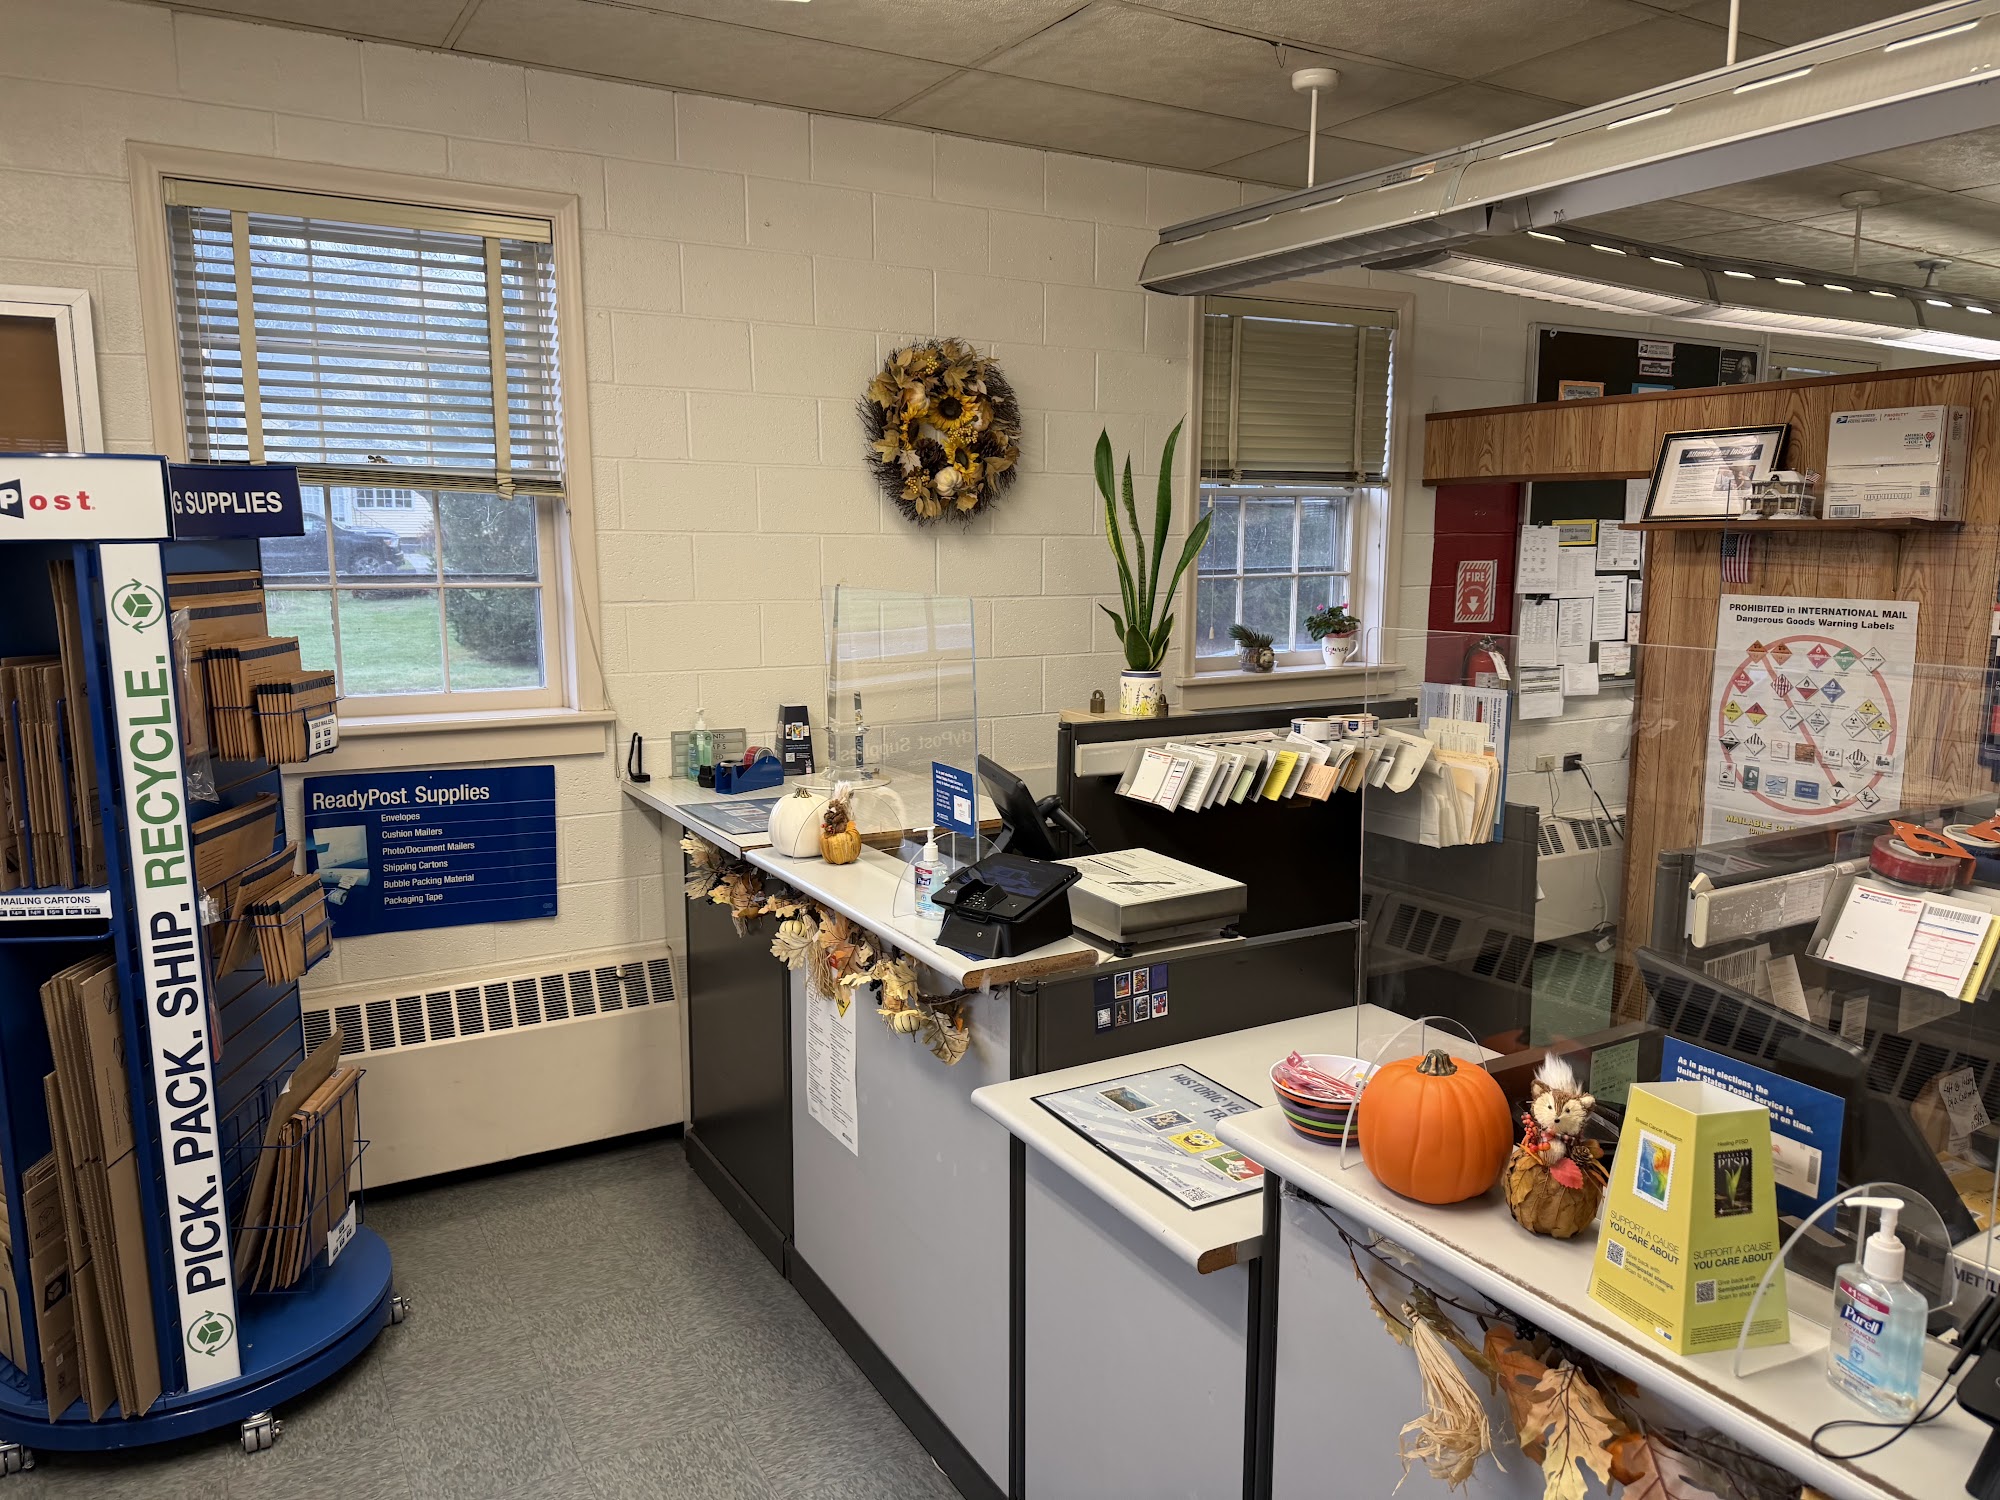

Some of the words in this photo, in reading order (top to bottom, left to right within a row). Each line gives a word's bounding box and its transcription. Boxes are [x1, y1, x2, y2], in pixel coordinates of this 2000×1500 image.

[184, 491, 283, 514] SUPPLIES
[1466, 571, 1485, 582] FIRE
[1729, 603, 1785, 613] PROHIBITED
[1787, 606, 1795, 614] in
[1798, 606, 1879, 618] INTERNATIONAL
[1882, 611, 1908, 619] MAIL
[1736, 614, 1784, 624] Dangerous
[1786, 617, 1815, 626] Goods
[1818, 618, 1858, 629] Warning
[1861, 621, 1895, 630] Labels
[124, 655, 188, 889] RECYCLE.
[312, 787, 408, 811] ReadyPost
[415, 785, 490, 804] Supplies
[1834, 789, 1840, 798] Y
[381, 812, 421, 823] Envelopes
[1725, 815, 1773, 829] MAILABLE
[382, 830, 413, 839] Cushion
[415, 827, 443, 836] Mailers
[382, 845, 446, 856] Photo/Document
[447, 841, 475, 850] Mailers
[383, 864, 417, 873] Shipping
[419, 860, 448, 869] Cartons
[383, 880, 410, 889] Bubble
[412, 877, 442, 887] Packing
[444, 874, 475, 883] Material
[0, 897, 42, 905] MAILING
[44, 896, 91, 904] CARTONS
[384, 895, 424, 907] Packaging
[425, 893, 443, 902] Tape
[150, 902, 198, 1018] SHIP.
[1678, 1056, 1687, 1066] As
[1689, 1059, 1697, 1069] in
[1698, 1064, 1715, 1076] past
[1717, 1071, 1754, 1091] elections,
[1756, 1084, 1769, 1096] the
[162, 1029, 214, 1166] PACK.
[1170, 1074, 1227, 1103] HISTORIC
[1677, 1066, 1701, 1080] United
[1703, 1075, 1727, 1090] States
[1729, 1085, 1752, 1101] Postal
[1754, 1094, 1784, 1112] Service
[1786, 1105, 1794, 1115] is
[1781, 1115, 1791, 1124] on
[1793, 1119, 1814, 1134] time.
[1718, 1157, 1750, 1168] PTSD
[177, 1175, 227, 1295] PICK.
[1610, 1210, 1645, 1236] SUPPORT
[1646, 1231, 1652, 1240] A
[1652, 1234, 1680, 1256] CAUSE
[1610, 1220, 1626, 1235] YOU
[1627, 1230, 1648, 1249] CARE
[1650, 1244, 1680, 1266] ABOUT
[1694, 1247, 1733, 1260] SUPPORT
[1735, 1246, 1742, 1254] A
[1744, 1242, 1772, 1252] CAUSE
[1694, 1261, 1713, 1270] YOU
[1715, 1256, 1740, 1268] CARE
[1742, 1252, 1774, 1262] ABOUT
[1845, 1305, 1879, 1334] Purell
[1844, 1322, 1876, 1344] ADVANCED
